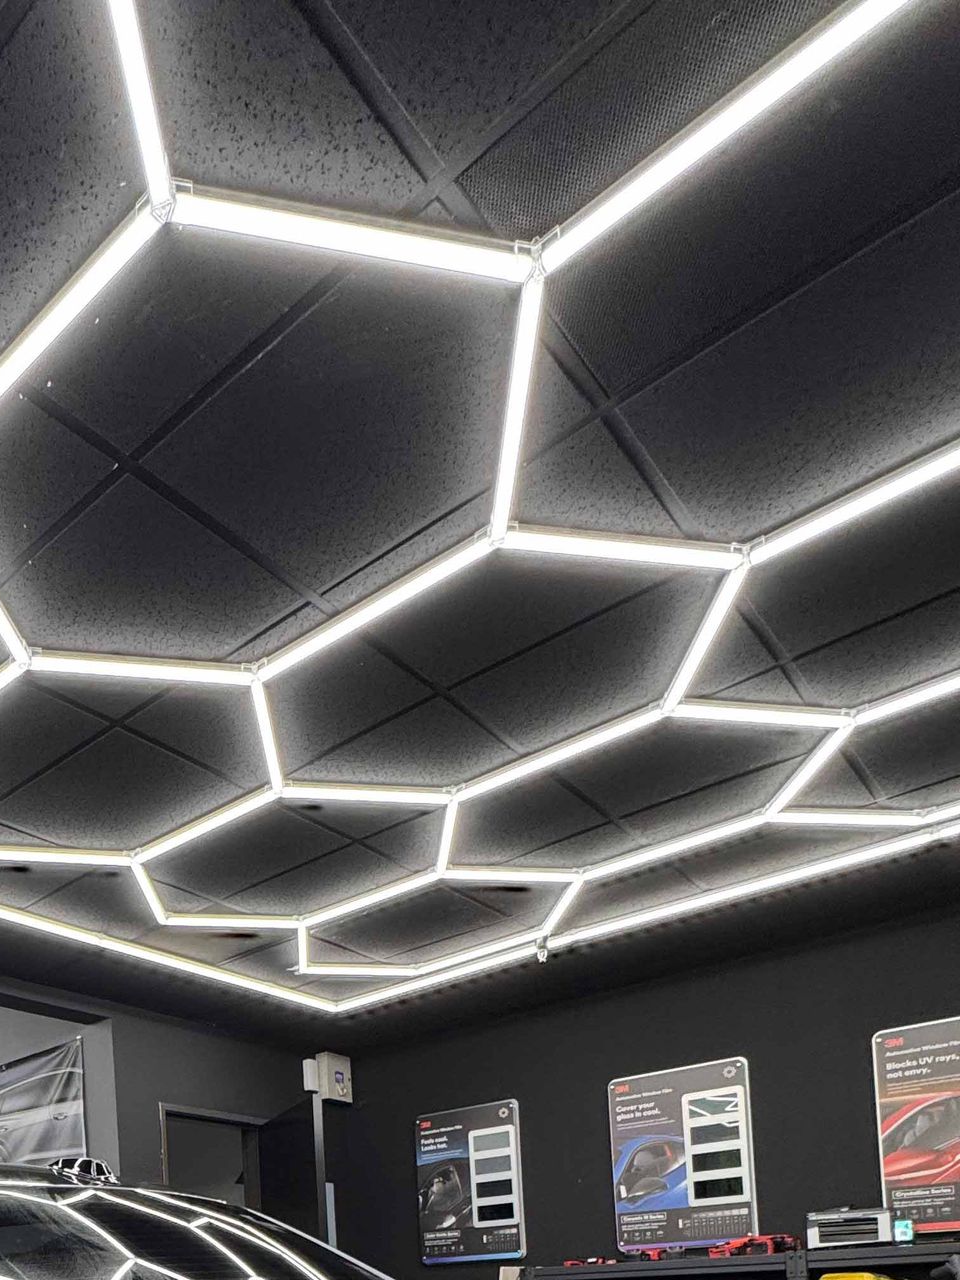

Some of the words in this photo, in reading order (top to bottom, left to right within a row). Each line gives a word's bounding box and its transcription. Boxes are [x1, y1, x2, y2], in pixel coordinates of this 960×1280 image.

[886, 1060, 917, 1071] Blocks
[918, 1056, 934, 1065] UV
[886, 1071, 903, 1079] not
[904, 1068, 931, 1077] envy.
[616, 1104, 637, 1113] Cover
[638, 1102, 655, 1111] your
